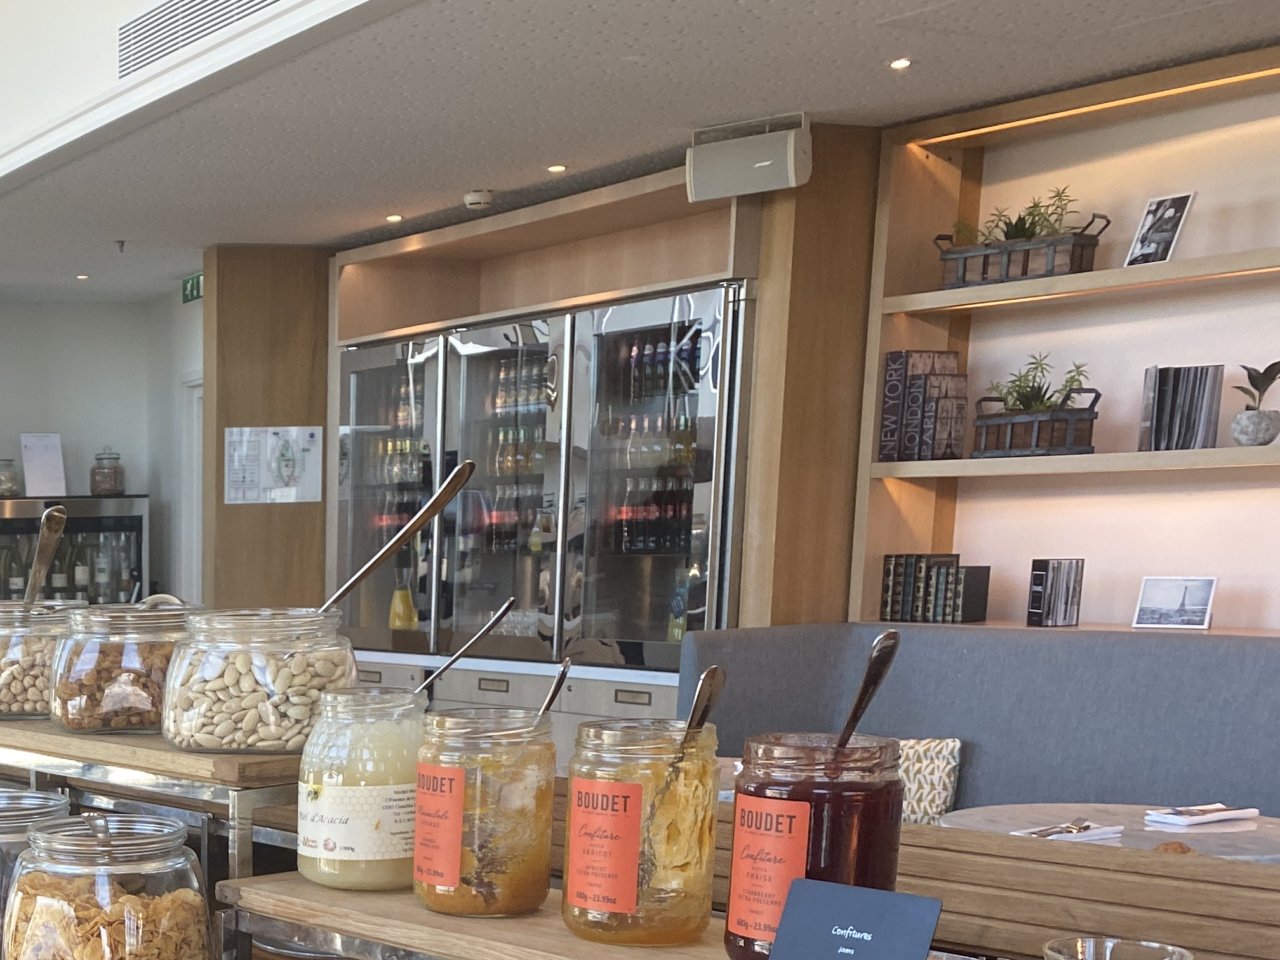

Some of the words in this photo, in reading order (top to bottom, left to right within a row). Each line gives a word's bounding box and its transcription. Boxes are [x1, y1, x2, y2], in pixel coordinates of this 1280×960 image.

[884, 358, 903, 408] YORK
[904, 378, 924, 455] LONDON
[921, 401, 936, 456] PARIS
[880, 415, 898, 454] NEW
[577, 791, 630, 813] BOUDET
[578, 823, 623, 841] Confiture
[740, 808, 796, 834] BOUDET
[740, 844, 786, 864] Confiture
[831, 925, 873, 941] Confitures
